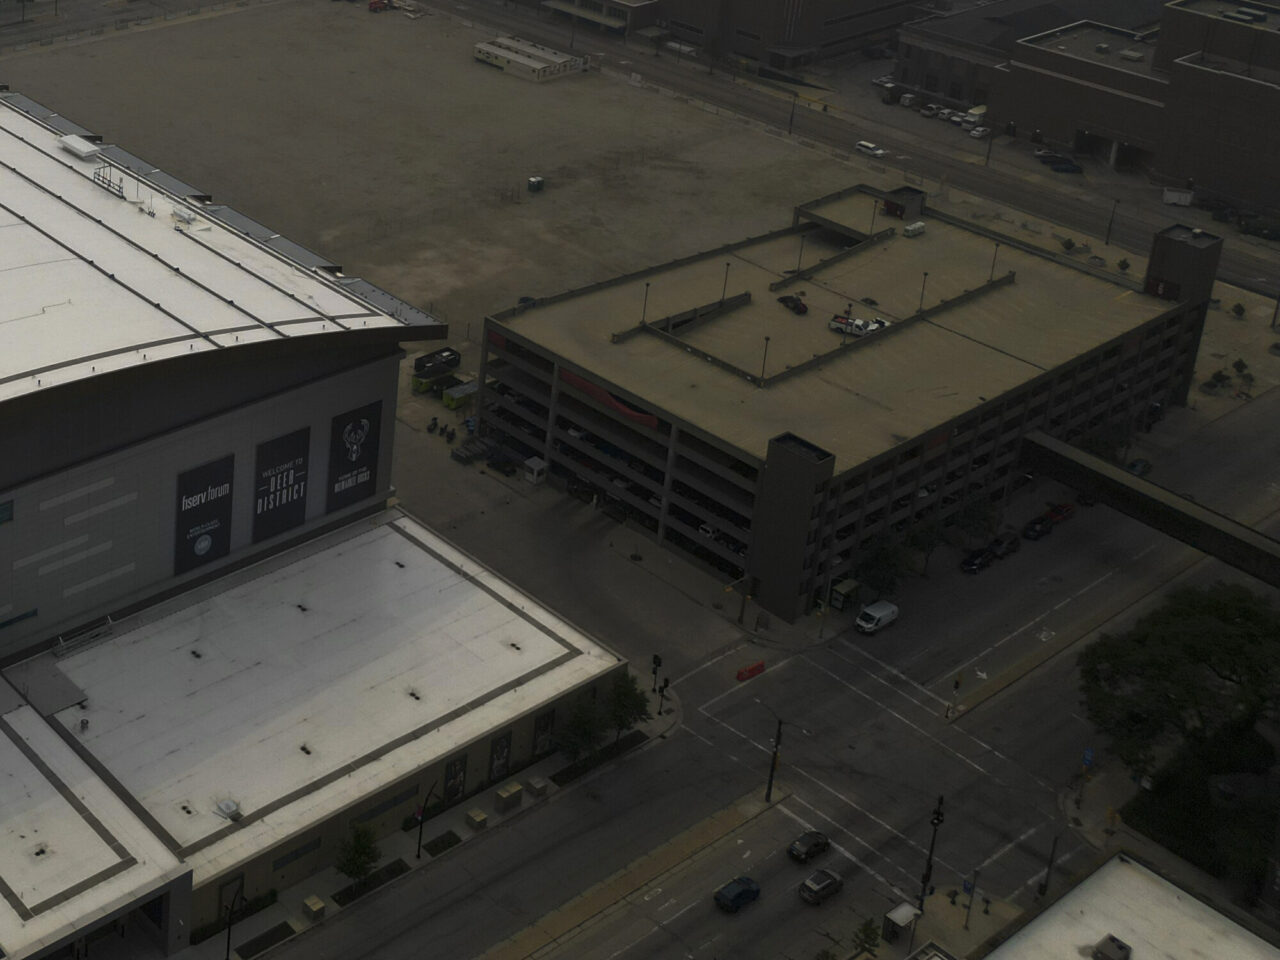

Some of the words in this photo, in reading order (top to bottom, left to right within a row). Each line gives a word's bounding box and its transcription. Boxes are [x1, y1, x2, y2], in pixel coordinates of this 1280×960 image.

[262, 462, 295, 479] WELCOME
[295, 457, 304, 466] TO
[270, 469, 294, 492] DEER
[207, 483, 231, 502] forum
[257, 481, 306, 515] DISTRICT
